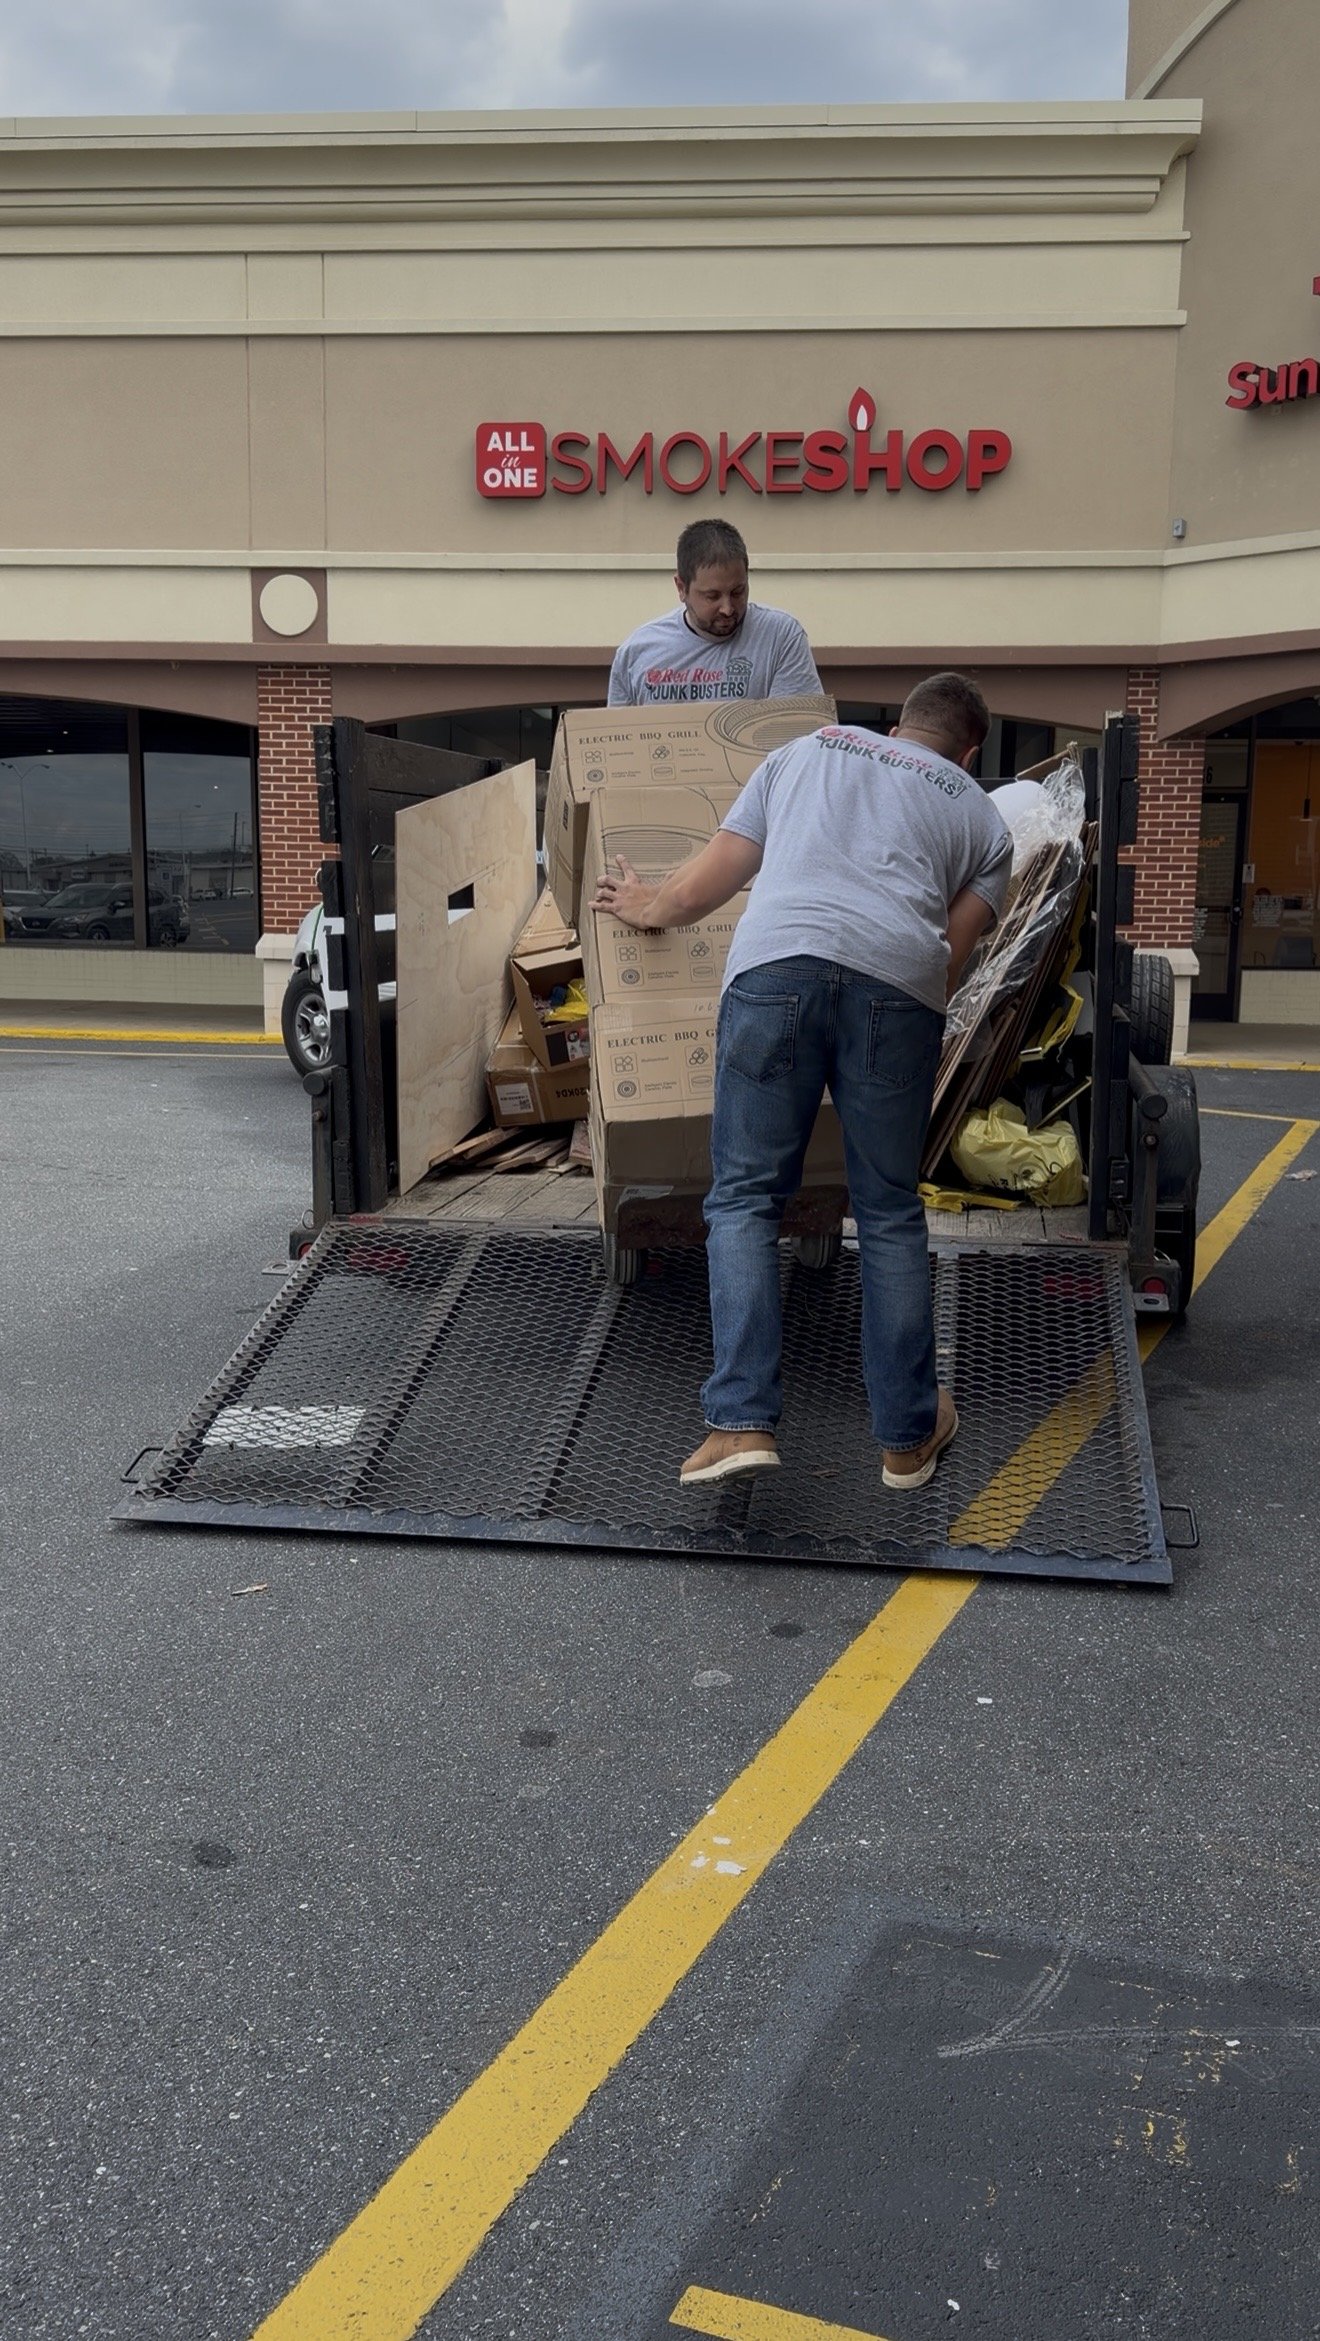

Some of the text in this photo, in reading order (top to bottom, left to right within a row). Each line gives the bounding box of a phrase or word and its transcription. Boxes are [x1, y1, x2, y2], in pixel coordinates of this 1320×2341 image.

[487, 431, 535, 451] ALL
[501, 454, 520, 468] in
[483, 467, 537, 488] ONE
[661, 667, 723, 683] Red Rose
[653, 681, 745, 700] JUNK BUSTERS
[579, 731, 701, 745] ELECTRIC BBQ GRILL
[844, 732, 932, 769] Red Rose
[825, 738, 957, 796] JUNK BUSTERS
[613, 927, 670, 939] ELECTRIC
[677, 925, 700, 935] BBQ
[607, 1034, 667, 1048] ELECTRIC
[674, 1030, 699, 1041] BBQ
